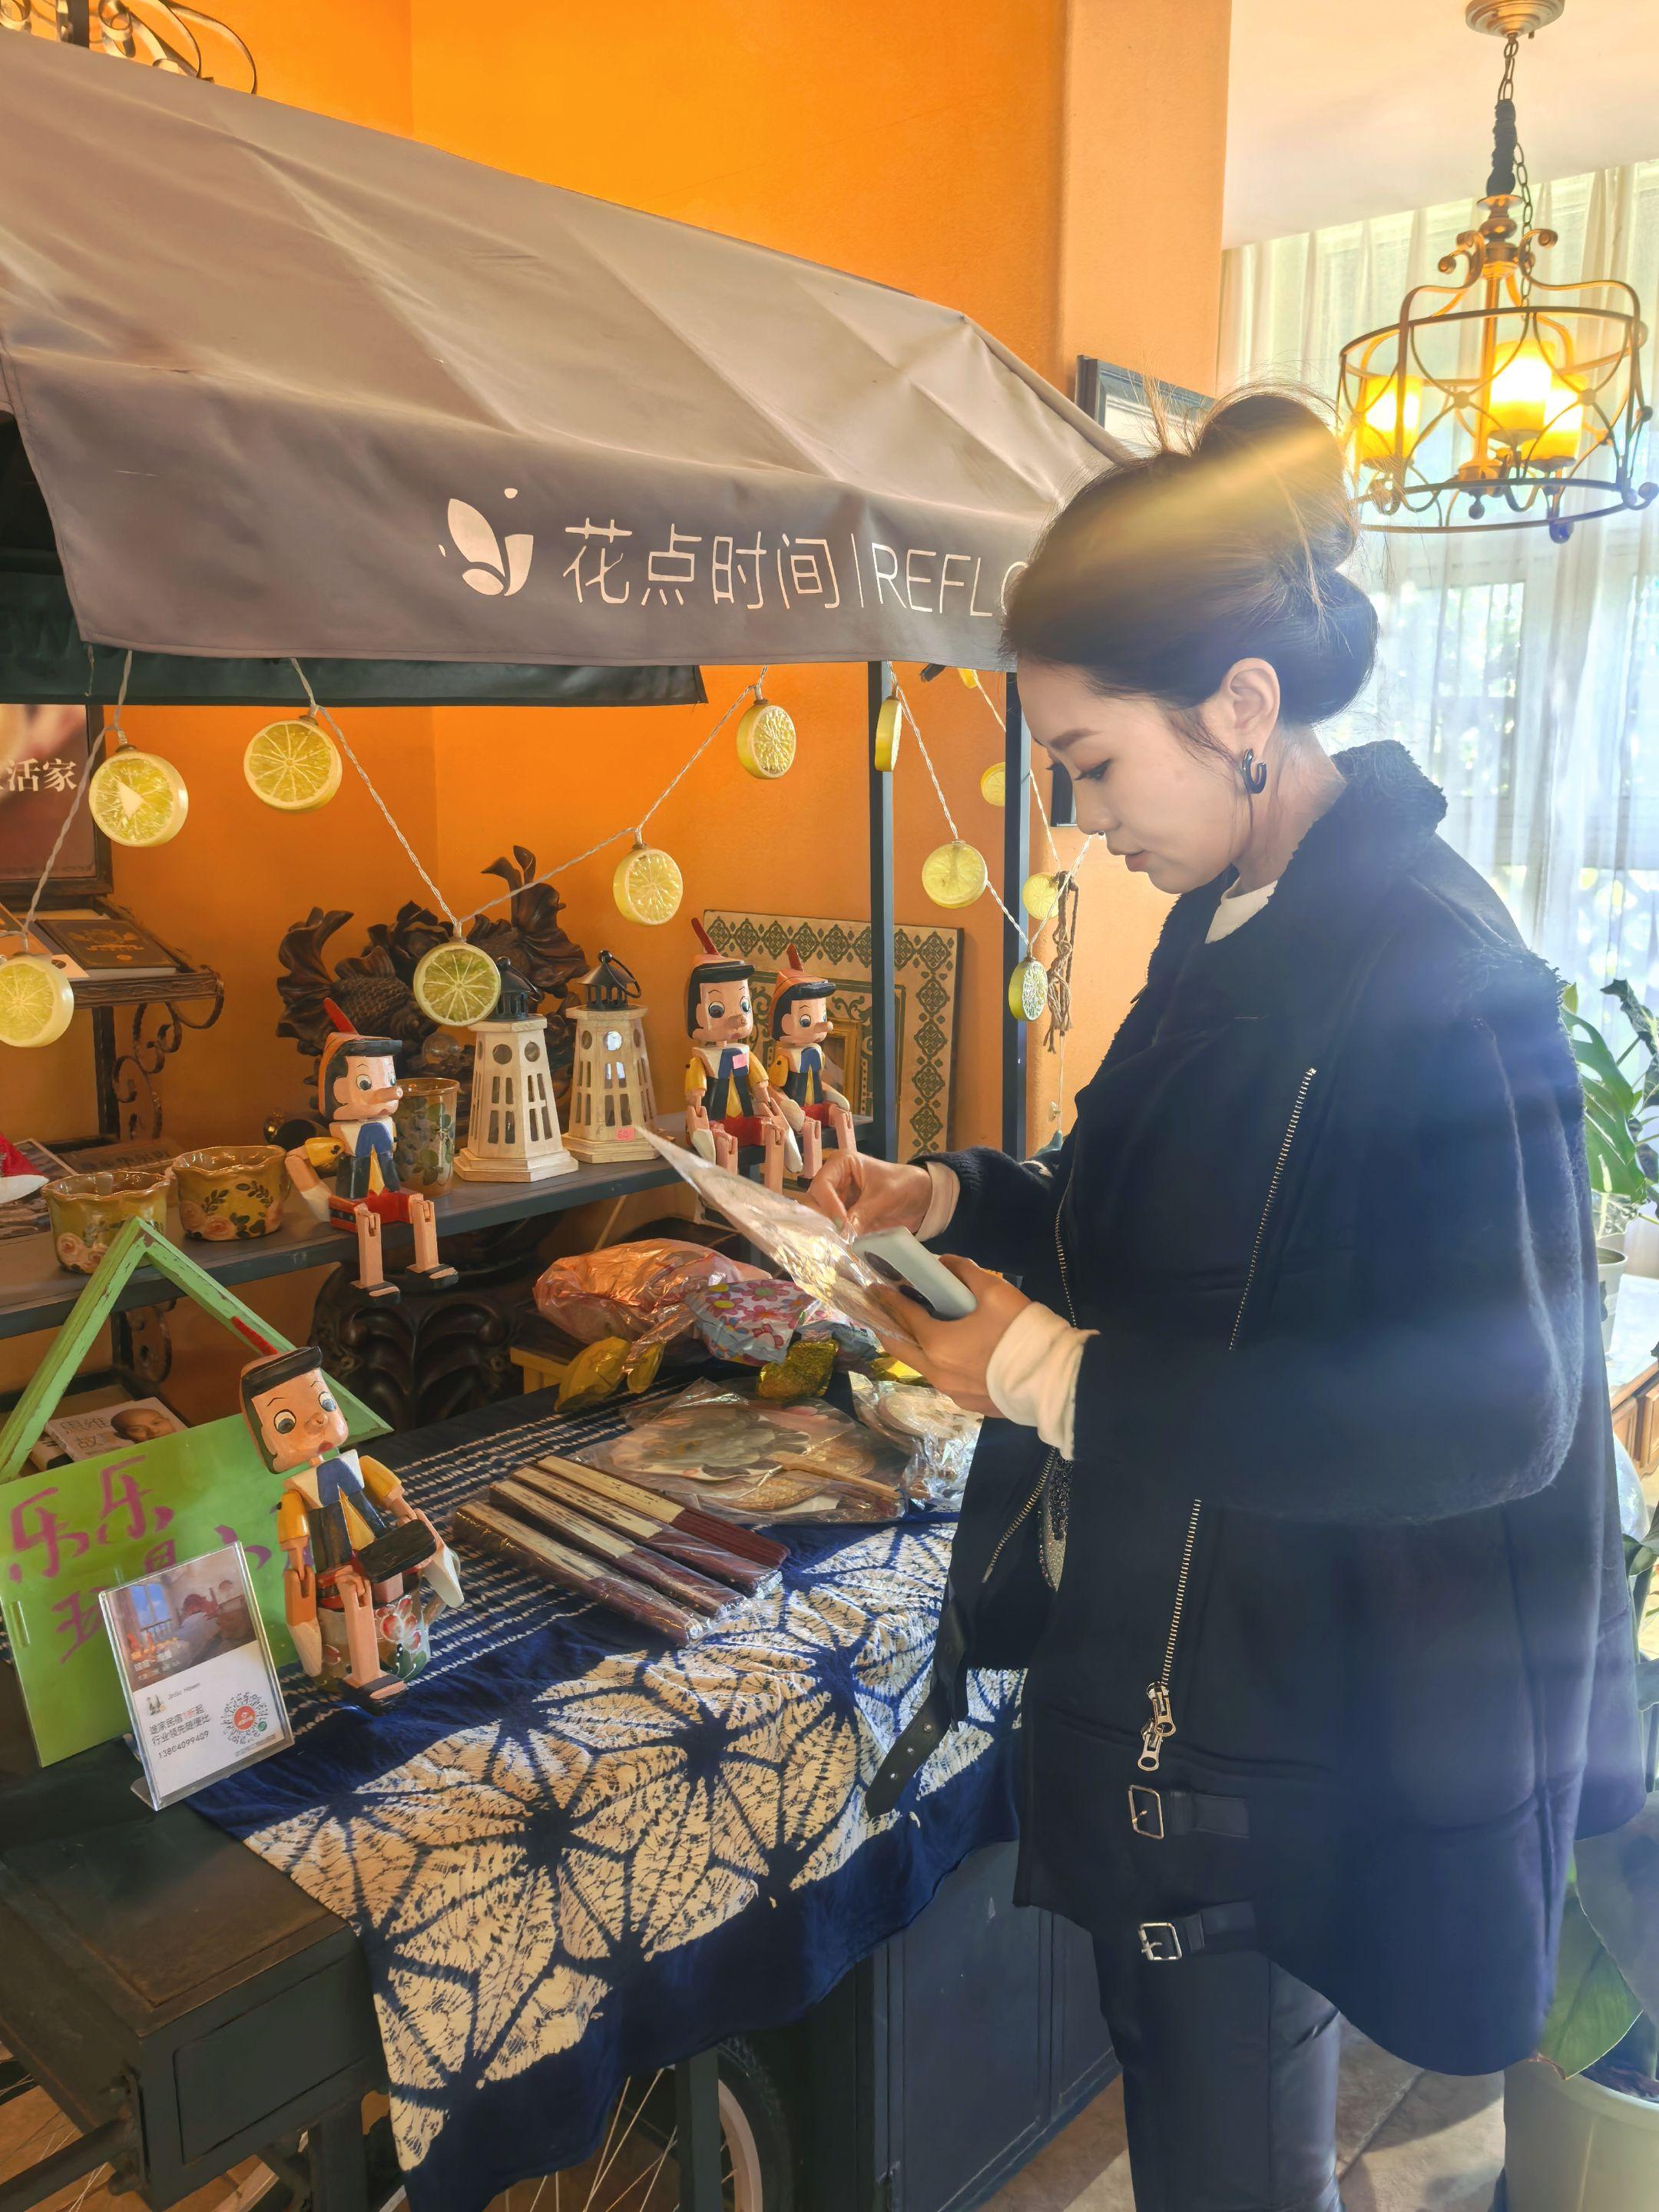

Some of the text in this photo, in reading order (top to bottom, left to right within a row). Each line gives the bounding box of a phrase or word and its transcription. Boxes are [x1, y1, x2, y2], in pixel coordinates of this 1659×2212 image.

[563, 517, 842, 610] 花点时间
[0, 757, 78, 793] 活家
[8, 1454, 175, 1585] 乐乐
